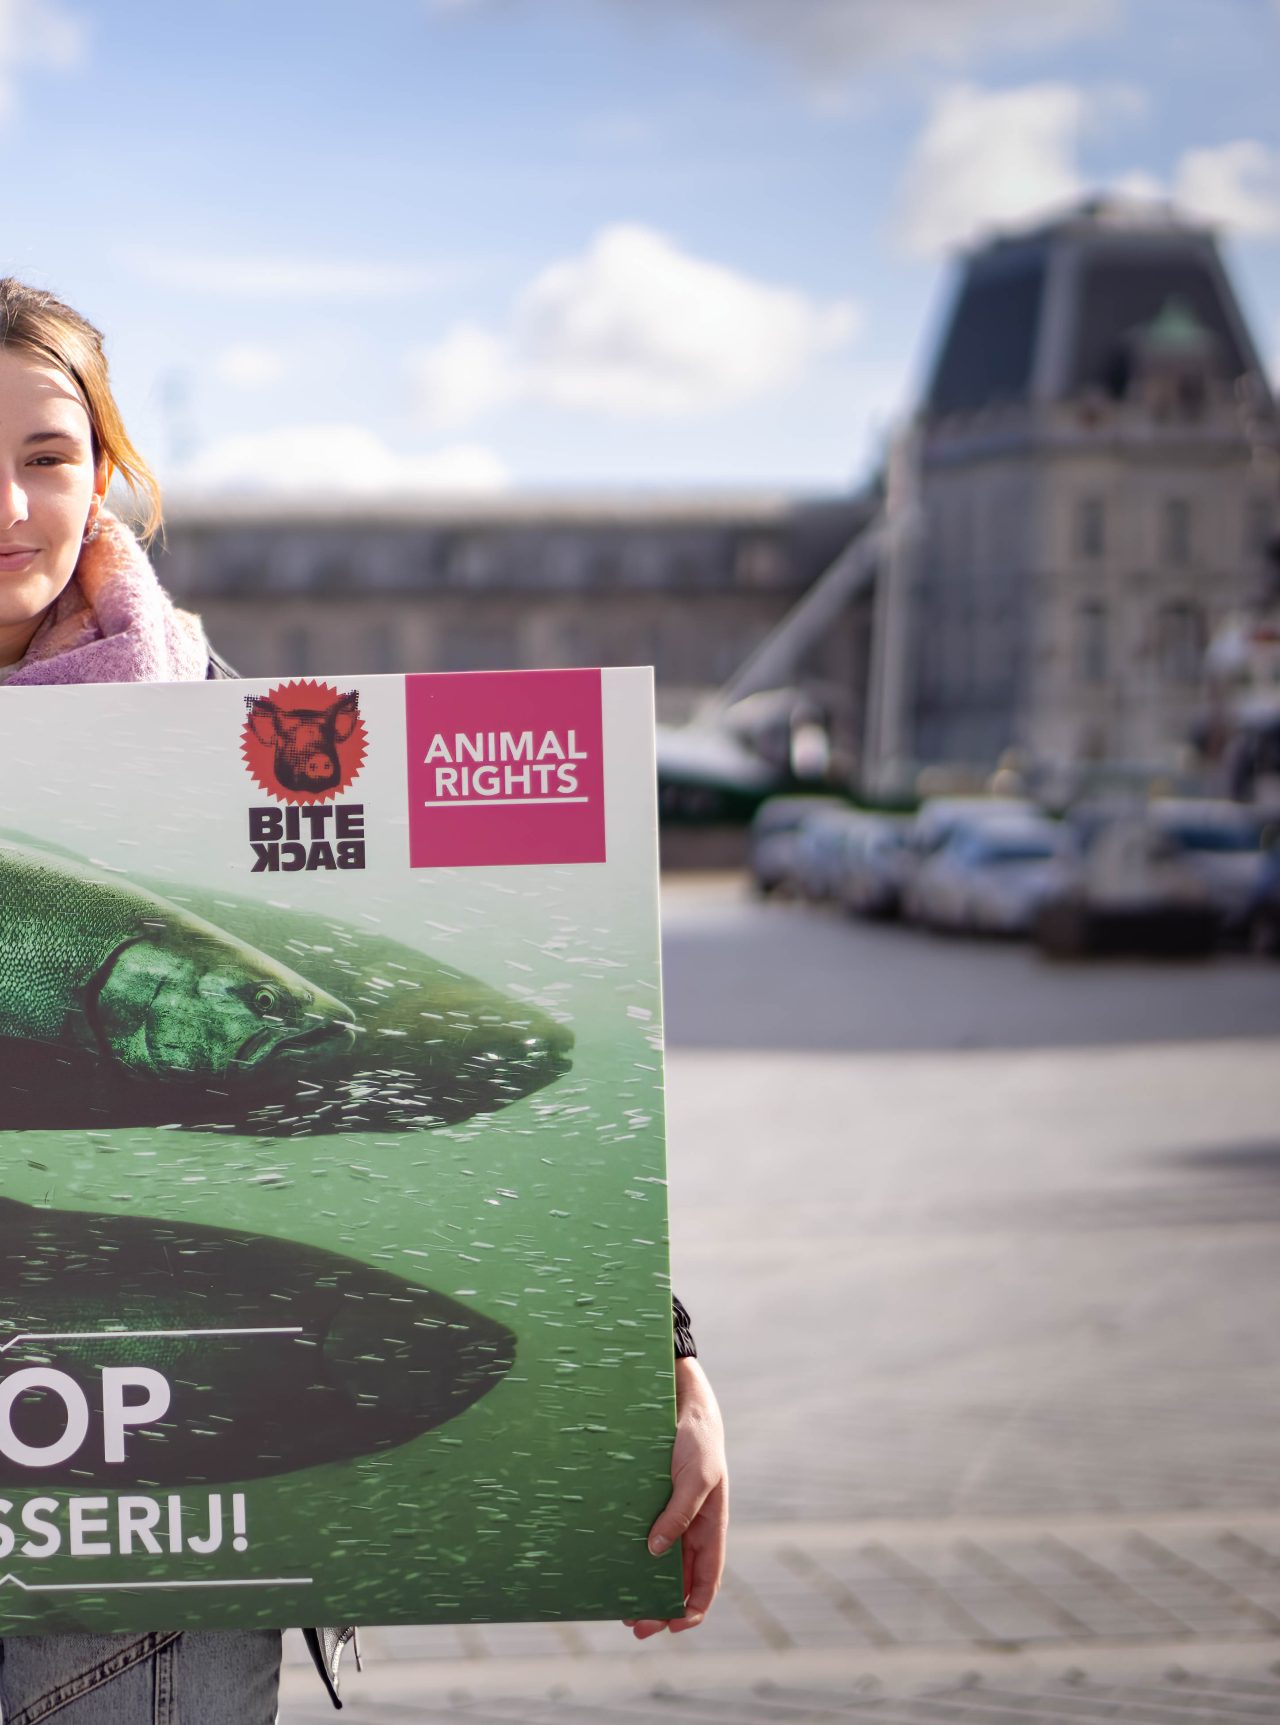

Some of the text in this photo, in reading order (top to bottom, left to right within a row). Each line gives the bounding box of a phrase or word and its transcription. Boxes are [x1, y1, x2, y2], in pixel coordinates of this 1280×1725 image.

[424, 730, 587, 763] ANIMAL
[435, 764, 578, 796] RIGHTS
[248, 804, 365, 841] BITE
